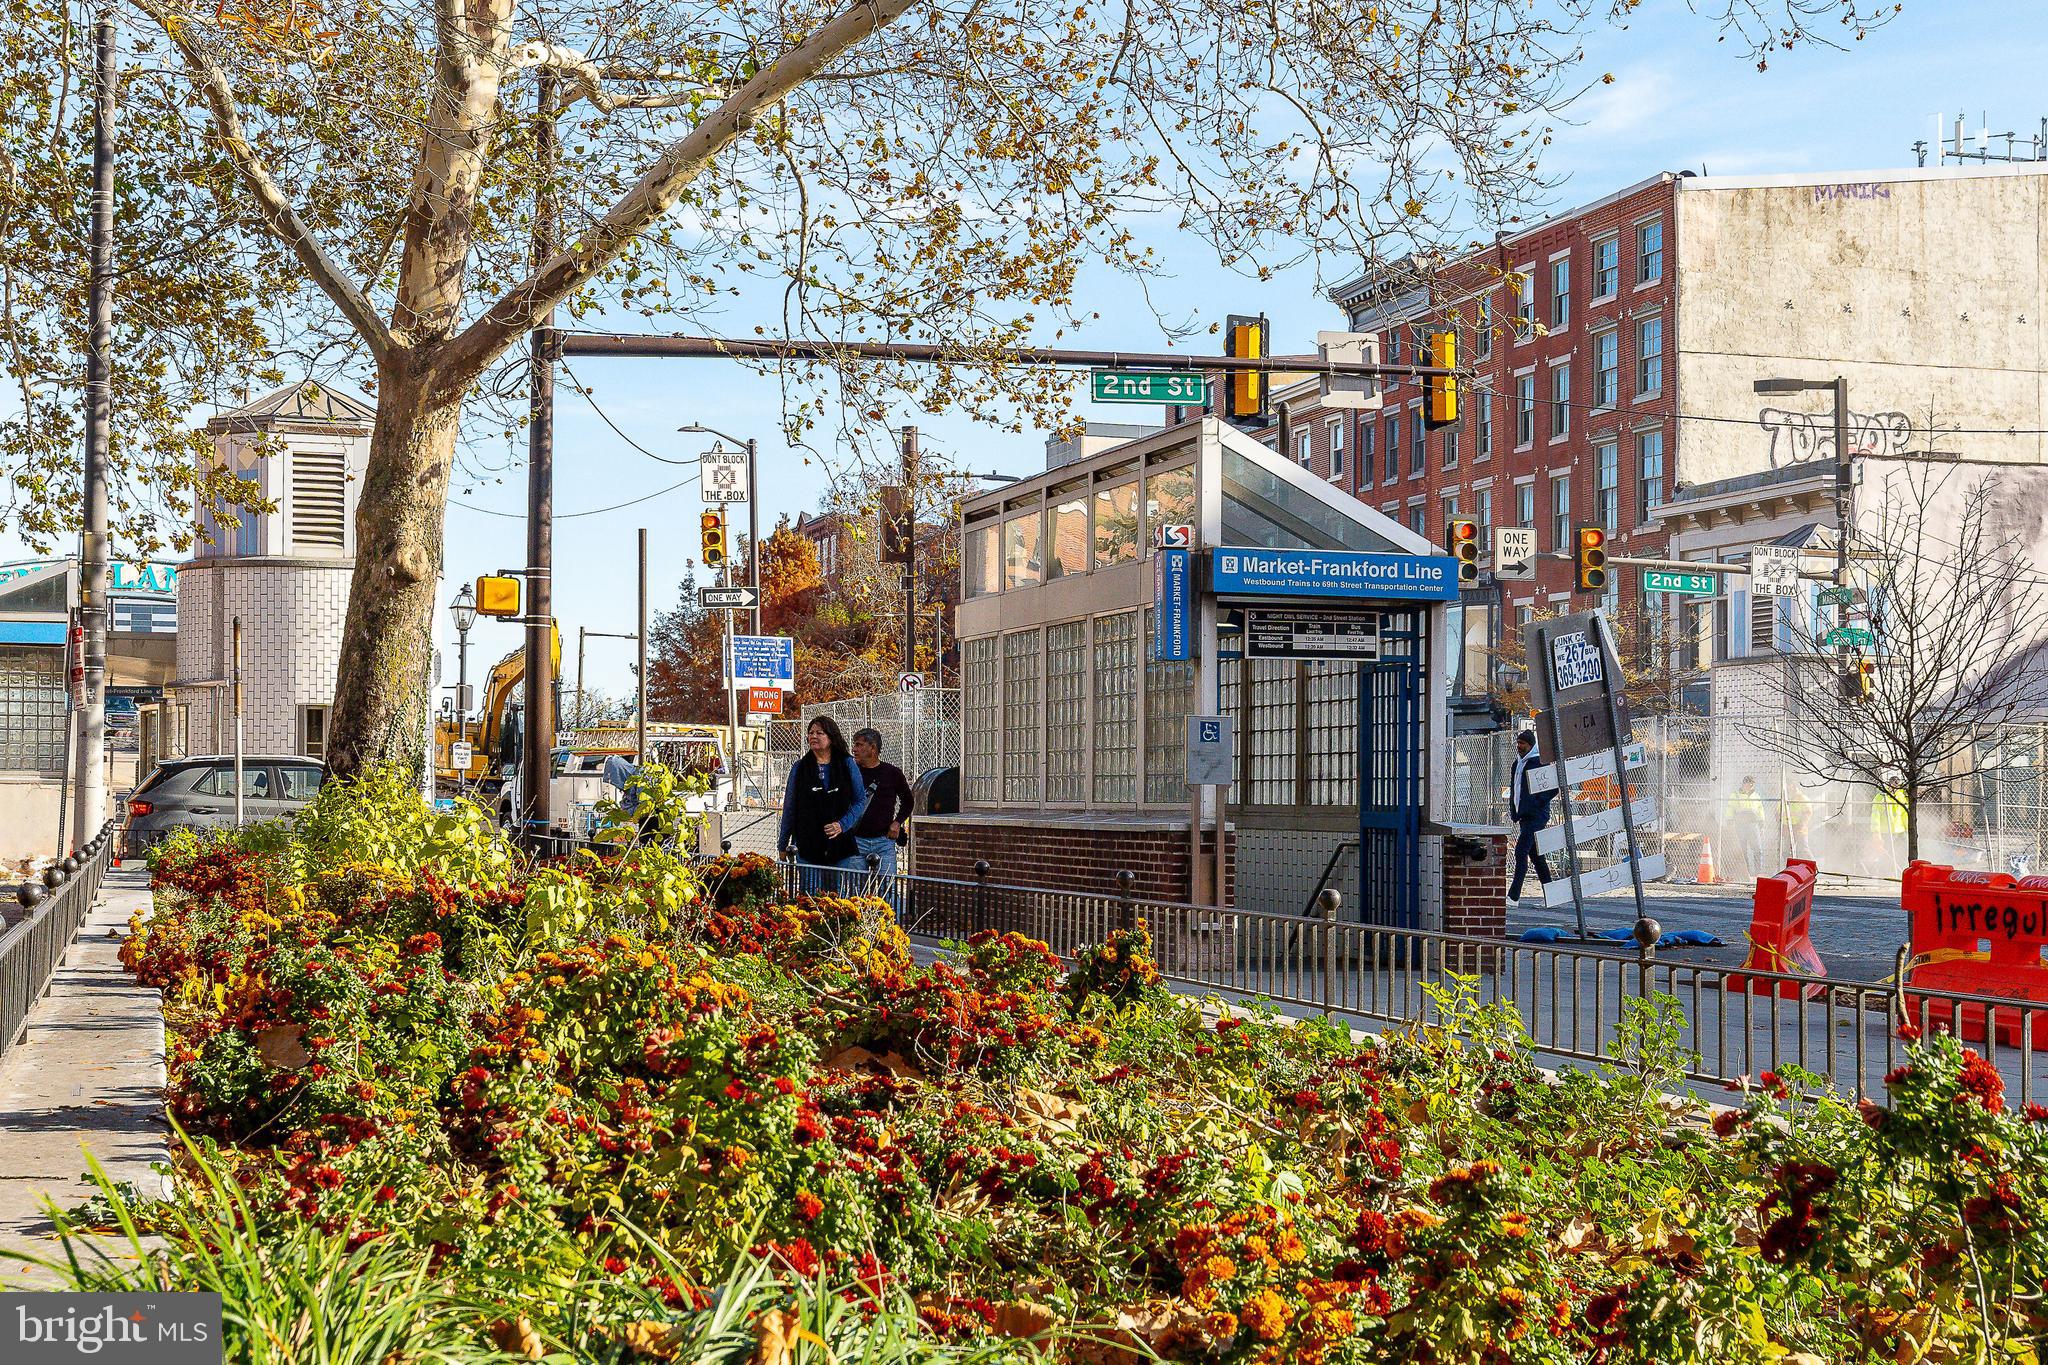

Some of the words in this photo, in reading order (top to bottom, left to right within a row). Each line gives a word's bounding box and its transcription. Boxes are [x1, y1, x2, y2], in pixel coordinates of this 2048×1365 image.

[1103, 375, 1151, 395] 2nd
[1167, 377, 1194, 396] St
[723, 455, 745, 464] BLOCK
[705, 491, 722, 500] THE
[727, 491, 745, 500] BOX
[1504, 533, 1528, 544] ONE
[1503, 546, 1529, 558] WAY
[1774, 548, 1796, 559] BLOCK
[1243, 556, 1398, 579] Market-Frankford
[1404, 562, 1443, 580] Line
[1243, 577, 1285, 587] Westbound
[1288, 579, 1310, 588] Trains
[1322, 580, 1338, 588] 69th
[1340, 581, 1362, 589] Street
[1364, 582, 1417, 591] Transportation
[1419, 583, 1443, 592] Center
[1651, 574, 1682, 587] 2nd
[1690, 576, 1708, 589] St
[1754, 583, 1772, 594] THE
[1776, 585, 1794, 595] BOX
[726, 593, 741, 601] WAY
[1173, 573, 1181, 656] MARKET-FRANKFORD
[1555, 635, 1574, 647] JUNK
[1556, 654, 1565, 662] WE
[1585, 646, 1597, 655] BUY
[1565, 641, 1585, 663] 267
[1558, 658, 1601, 688] 369-3200
[753, 690, 779, 699] WRONG
[757, 701, 773, 709] WAY
